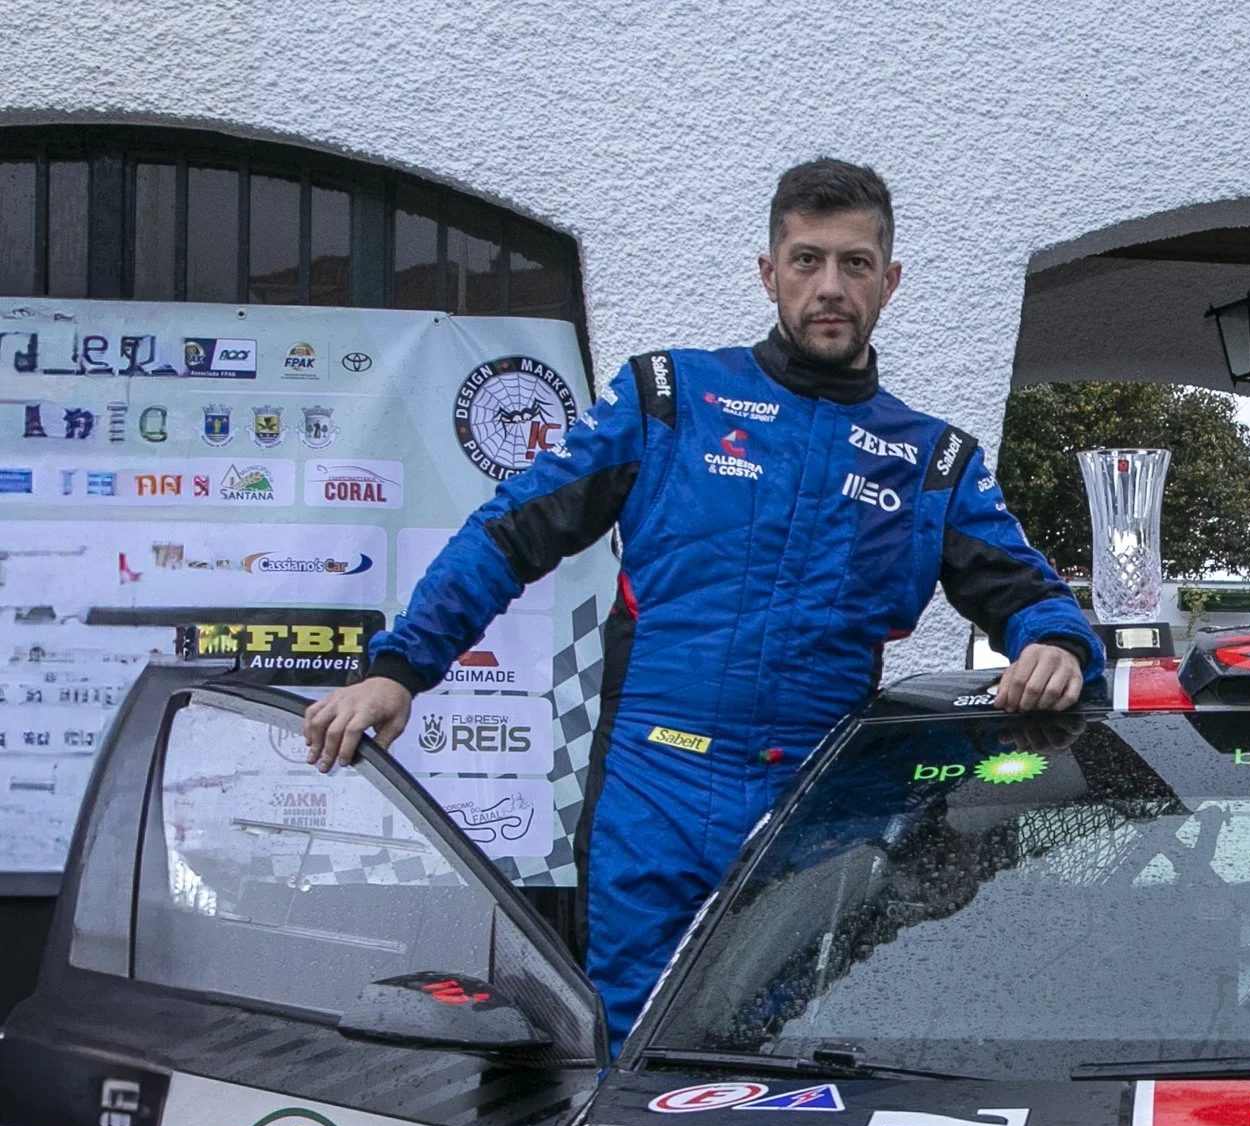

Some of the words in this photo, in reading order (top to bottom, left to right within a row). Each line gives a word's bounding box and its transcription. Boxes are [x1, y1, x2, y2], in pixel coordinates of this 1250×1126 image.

[284, 357, 316, 368] FPAK
[651, 355, 672, 398] Sabelt
[456, 365, 493, 419] DESIGN
[521, 359, 577, 431] MARKETIN
[848, 424, 918, 465] ZEISS
[936, 431, 963, 476] Sabelt
[463, 439, 529, 480] PUBLIC
[704, 453, 764, 475] CALDEIRA
[708, 464, 717, 474] &
[718, 466, 758, 480] COSTA
[220, 488, 274, 501] SANTANA
[324, 481, 388, 503] CORAL
[258, 556, 324, 572] Cassiano's
[325, 557, 348, 572] Car
[250, 654, 359, 671] Automóveis
[444, 670, 515, 683] OGIMADE
[451, 724, 532, 753] REIS
[656, 729, 704, 750] Sabelt
[913, 764, 966, 782] bp
[284, 793, 327, 807] AKM
[283, 816, 326, 827] KARTING
